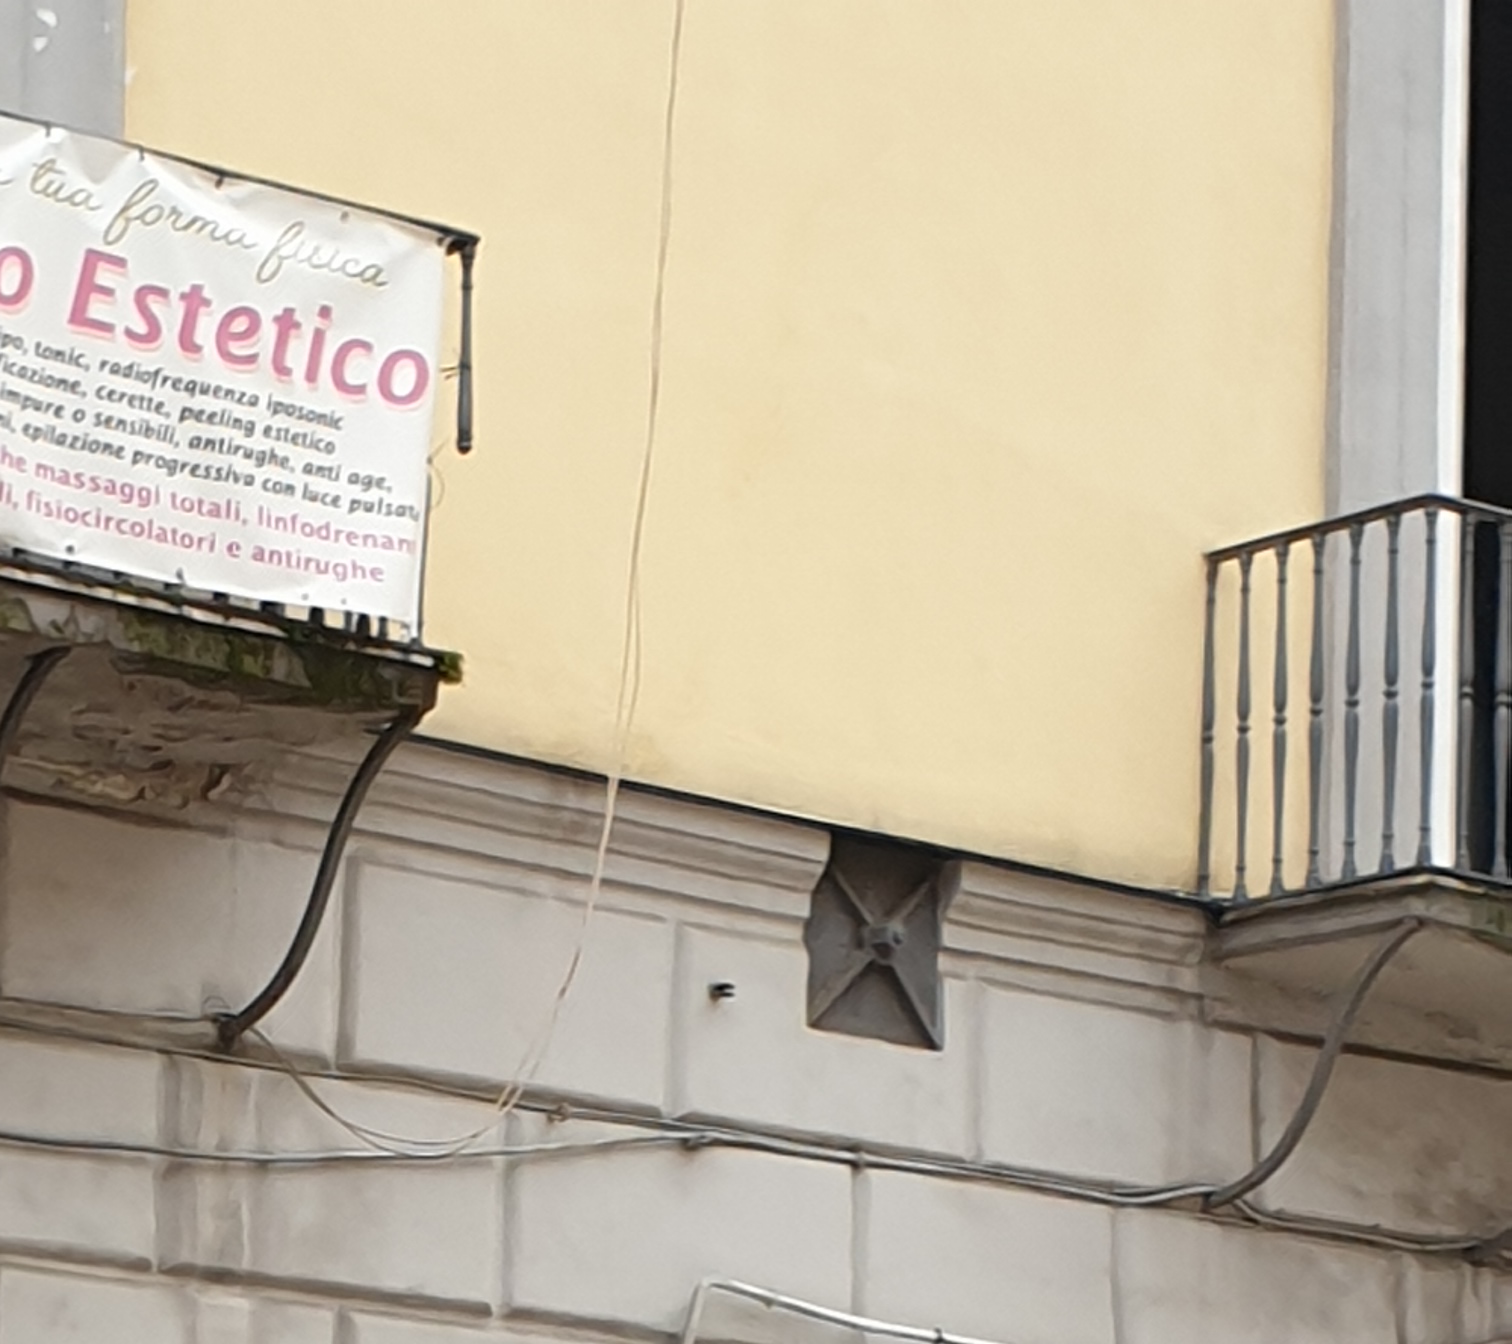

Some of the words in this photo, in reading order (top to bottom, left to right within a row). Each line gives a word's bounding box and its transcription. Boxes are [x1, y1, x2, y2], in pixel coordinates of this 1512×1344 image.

[29, 157, 102, 212] tua
[103, 178, 257, 246] forma
[256, 221, 389, 288] fisica
[67, 247, 430, 406] Estetico
[95, 384, 172, 419] cerette,
[178, 406, 256, 438] peeling
[263, 423, 336, 456] estetico
[98, 358, 260, 407] radiofrequenza
[0, 382, 65, 420] impure
[72, 408, 86, 423] o
[93, 411, 180, 449] sensibili,
[302, 460, 342, 482] anti
[21, 421, 126, 460] epilazione
[131, 447, 256, 487] progressiva
[261, 476, 296, 496] con
[301, 482, 343, 508] luce
[34, 461, 161, 508] massaggi
[26, 489, 216, 553] fisiocircolatori
[226, 540, 242, 559] e
[251, 543, 385, 582] antirughe
